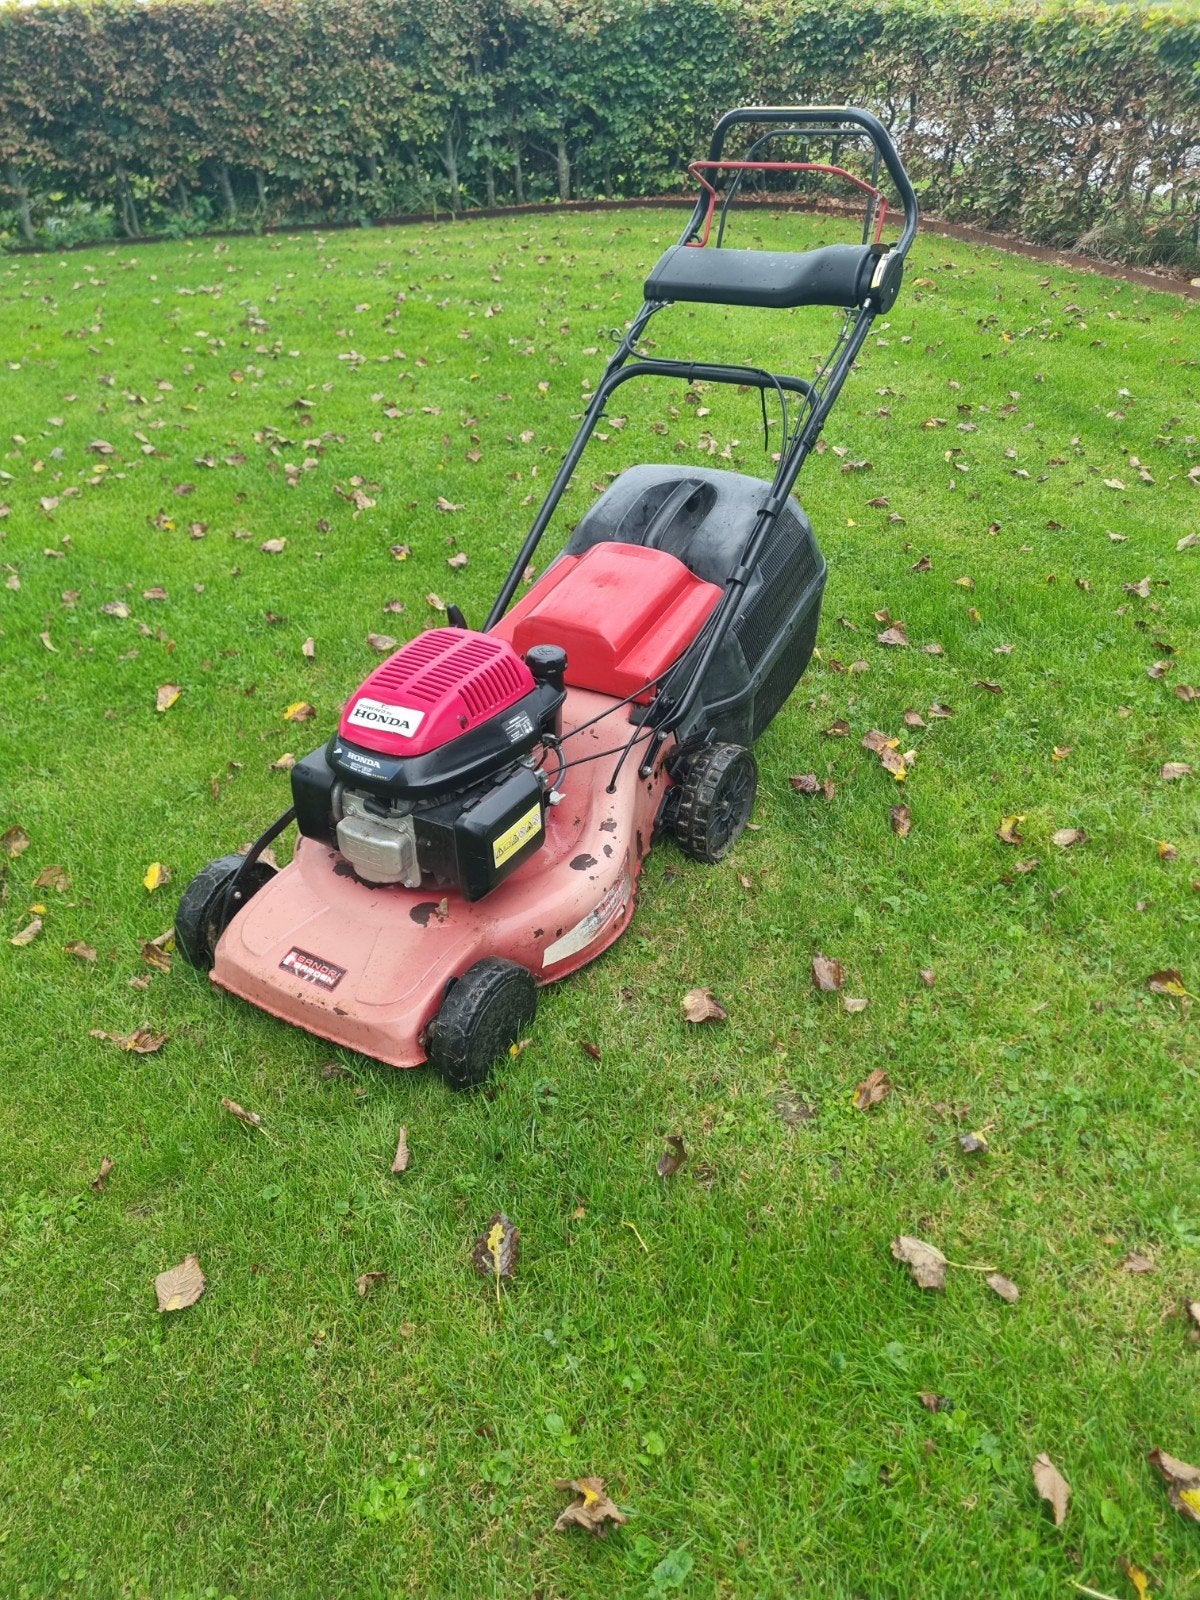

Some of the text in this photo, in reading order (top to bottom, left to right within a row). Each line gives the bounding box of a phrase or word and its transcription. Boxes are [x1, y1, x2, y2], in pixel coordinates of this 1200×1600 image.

[354, 708, 410, 729] HONDA
[347, 751, 381, 769] HONDA
[293, 961, 335, 985] GARDEN
